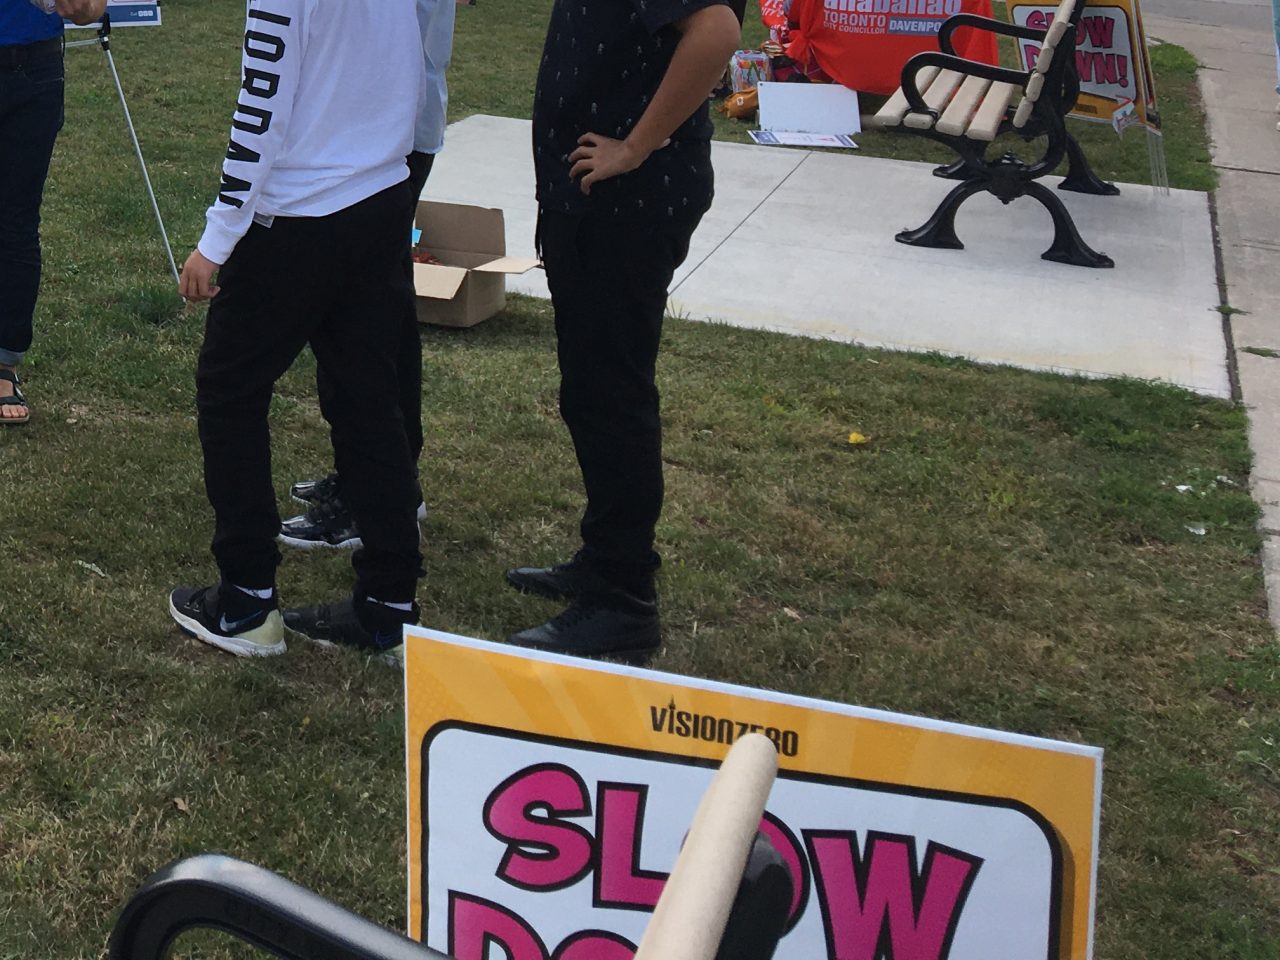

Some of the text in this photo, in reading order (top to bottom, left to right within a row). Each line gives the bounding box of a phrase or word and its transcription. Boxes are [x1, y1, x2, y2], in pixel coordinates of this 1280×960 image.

[824, 10, 886, 27] TORONTO
[889, 19, 942, 33] DAVENPO
[824, 21, 885, 34] CITY COUNCILLOR
[1024, 45, 1128, 88] DWN!
[482, 761, 985, 960] SLW
